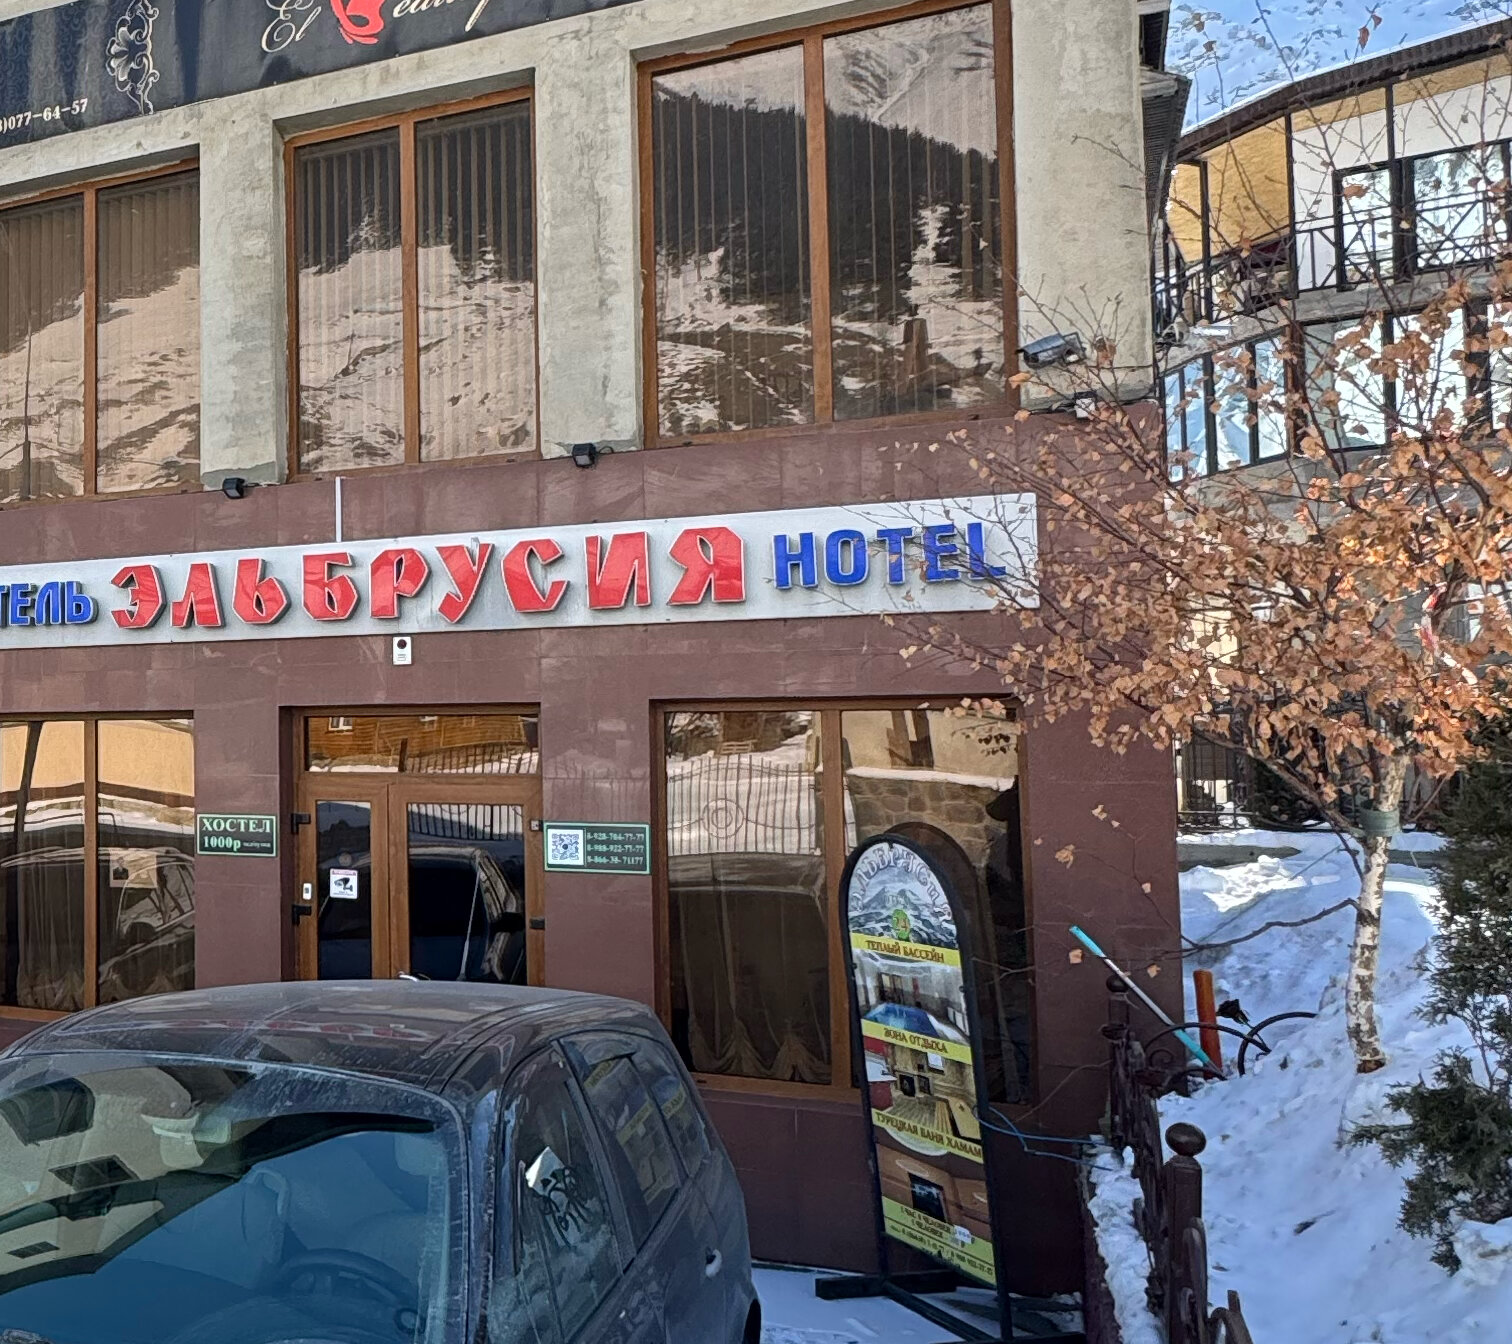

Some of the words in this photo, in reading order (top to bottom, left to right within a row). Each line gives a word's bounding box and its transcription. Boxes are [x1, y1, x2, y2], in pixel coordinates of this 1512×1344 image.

[110, 526, 746, 629] ЭЛЬБРУСИЯ
[772, 522, 1007, 589] HOTEL
[202, 818, 271, 833] ХОСТЕЛ
[865, 940, 903, 956] ТЕПЛЫЙ
[903, 947, 945, 964] БАССЕЙН
[884, 1027, 908, 1043] ЗОНА
[909, 1032, 948, 1054] ОТДЫХА
[875, 1111, 918, 1136] ТУРЕЦКАЯ
[920, 1127, 945, 1145] БАНЯ
[946, 1136, 982, 1158] ХАМАМ
